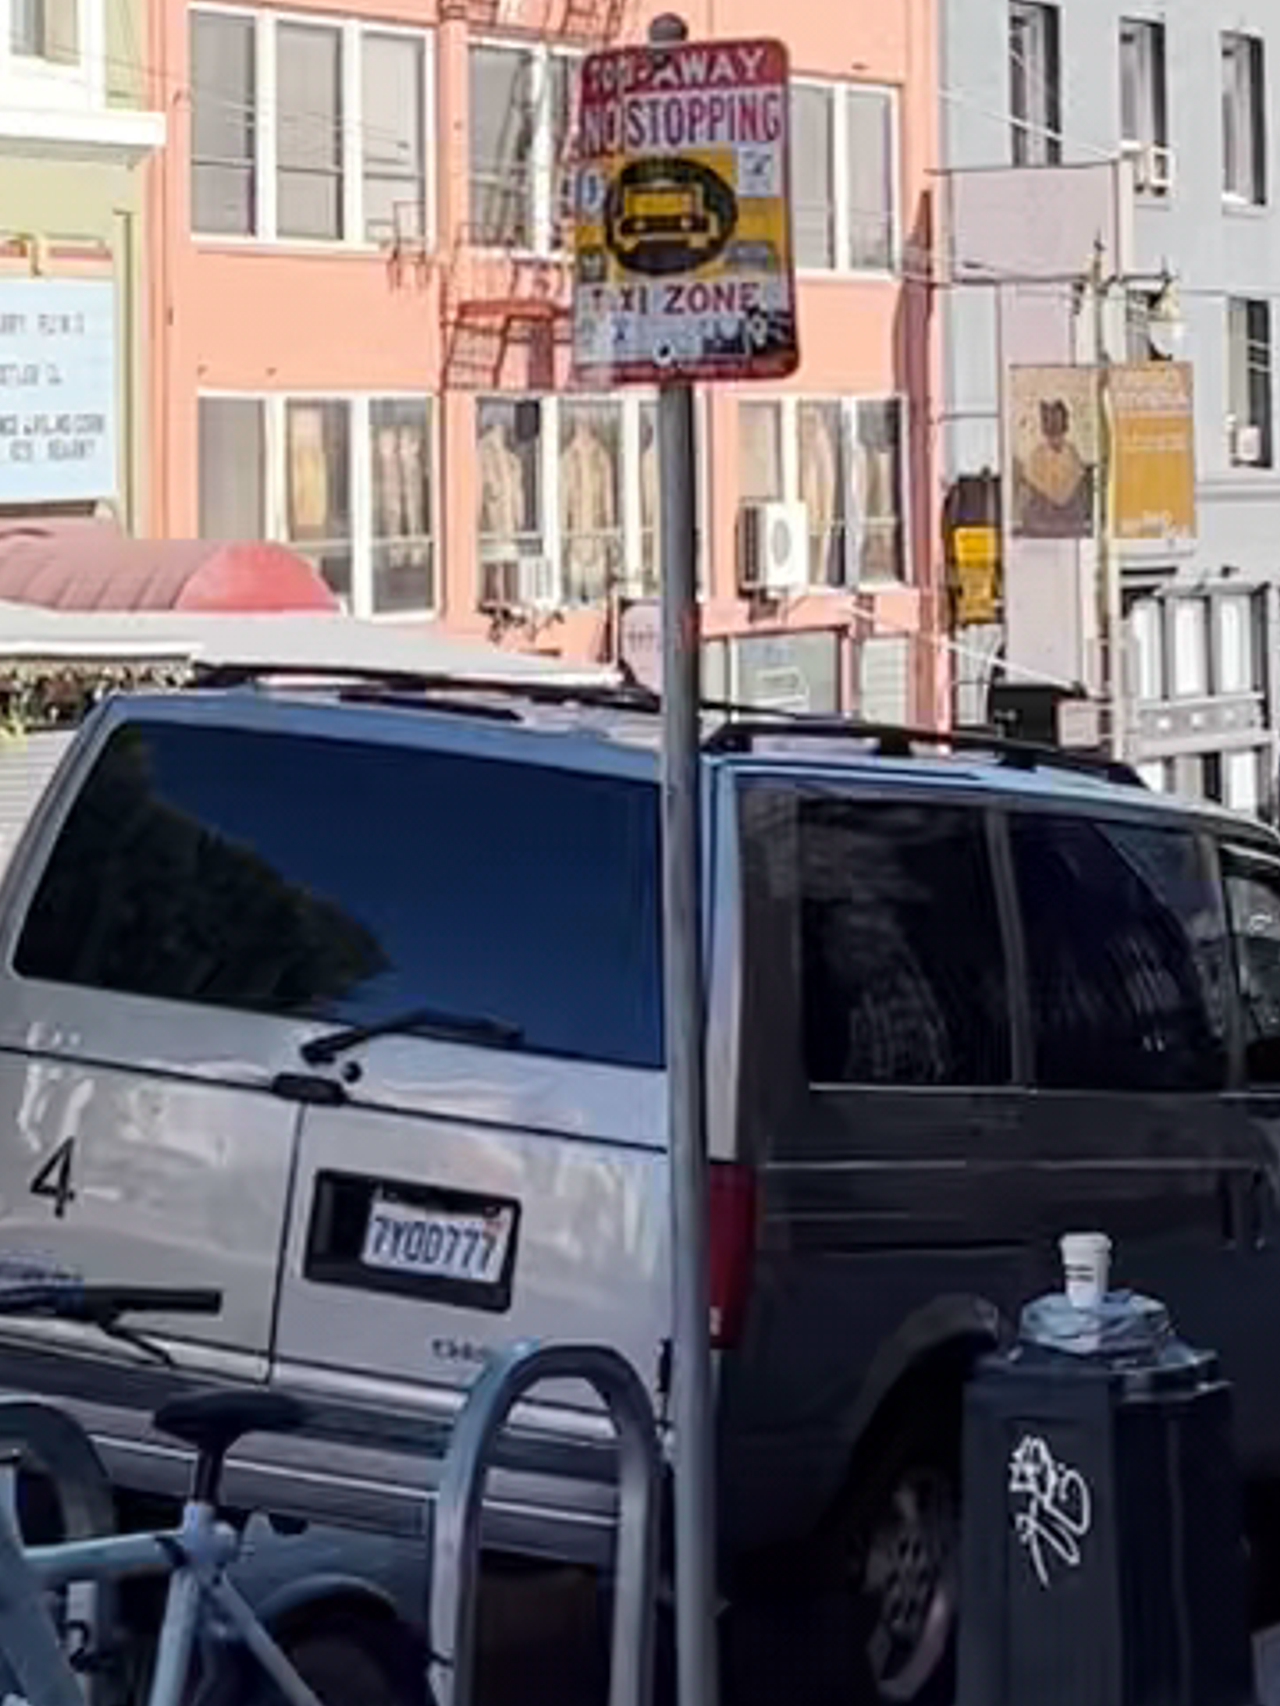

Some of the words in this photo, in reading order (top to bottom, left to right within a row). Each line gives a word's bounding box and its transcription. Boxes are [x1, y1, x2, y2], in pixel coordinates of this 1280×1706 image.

[626, 91, 782, 147] STOPPING
[589, 284, 648, 316] TXI
[663, 282, 760, 316] ZONE
[29, 1136, 76, 1219] 4
